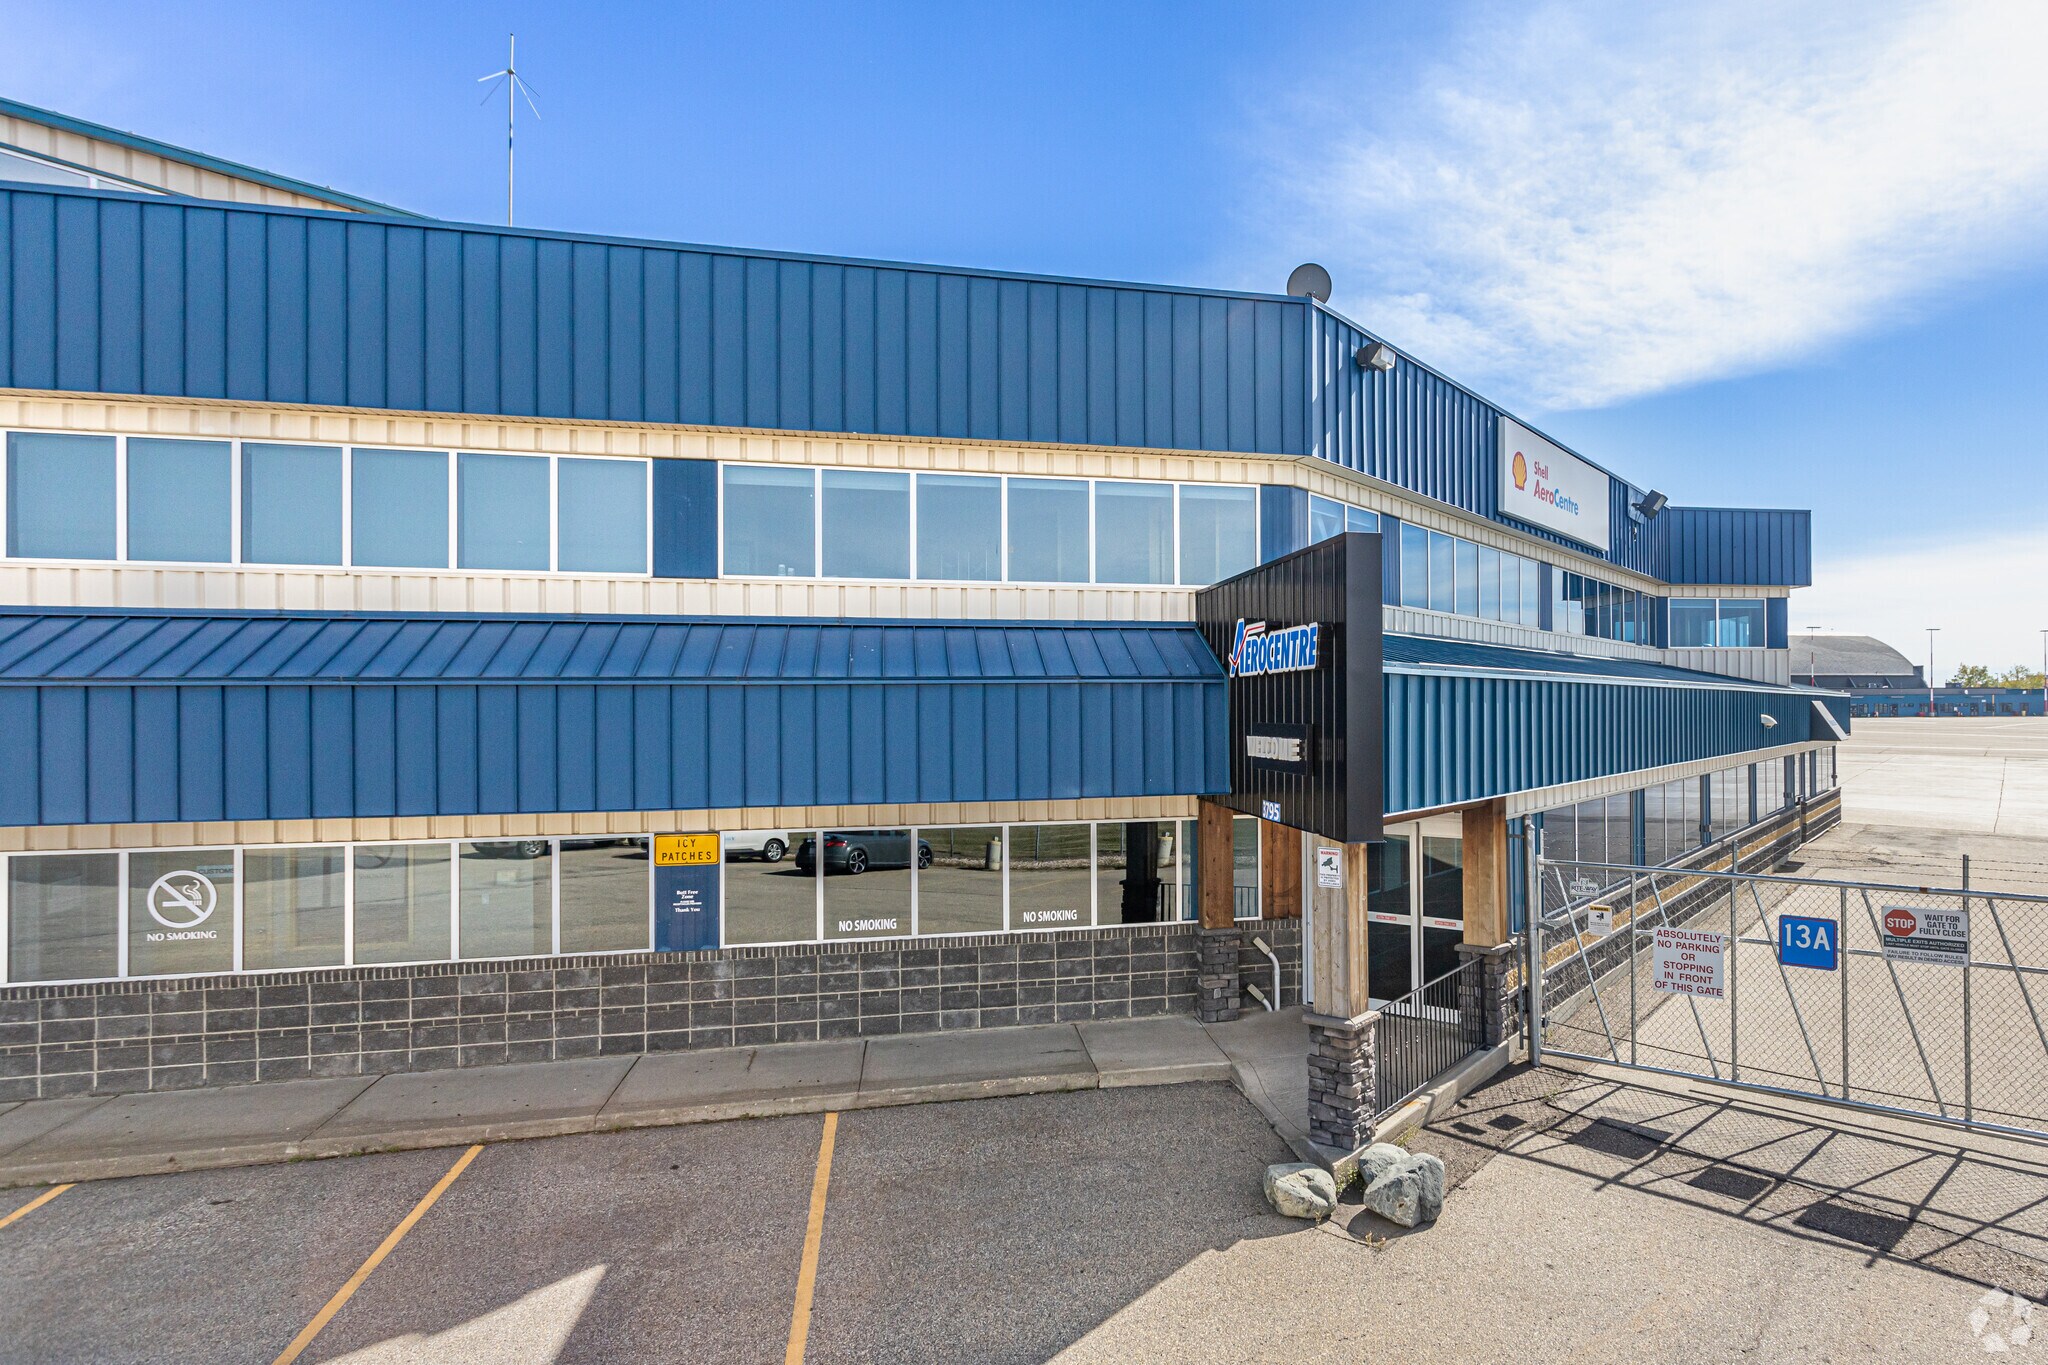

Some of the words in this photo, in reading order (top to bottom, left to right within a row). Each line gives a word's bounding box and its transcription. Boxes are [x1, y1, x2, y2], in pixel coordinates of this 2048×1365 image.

[1534, 461, 1549, 480] Shell
[1533, 480, 1579, 516] AeroCentre
[1229, 618, 1319, 677] AEROCENTRE
[677, 839, 696, 848] ICY
[661, 851, 712, 861] PATCHES
[1023, 911, 1036, 923] NO
[1037, 909, 1078, 922] SMOKING
[1924, 914, 1943, 922] WAIT
[1945, 915, 1960, 923] FOR
[838, 920, 853, 932] NO
[854, 918, 897, 931] SMOKING
[1887, 918, 1915, 929] STOP
[1926, 921, 1947, 929] GATE
[146, 932, 164, 942] NO
[166, 930, 217, 941] SMOKING
[1656, 929, 1721, 943] ABSOLUTELY
[1784, 923, 1831, 951] 13A
[1942, 930, 1966, 938] CLOSE
[1657, 940, 1672, 948] NO
[1675, 941, 1720, 954] PARKING
[1928, 940, 1965, 948] AUTHORIZED
[1681, 952, 1696, 961] OR
[1663, 960, 1714, 974] STOPPING
[1664, 971, 1674, 979] IN
[1679, 973, 1713, 984] FRONT
[1654, 980, 1668, 989] OF
[1671, 982, 1693, 992] THIS
[1696, 986, 1723, 997] GATE
